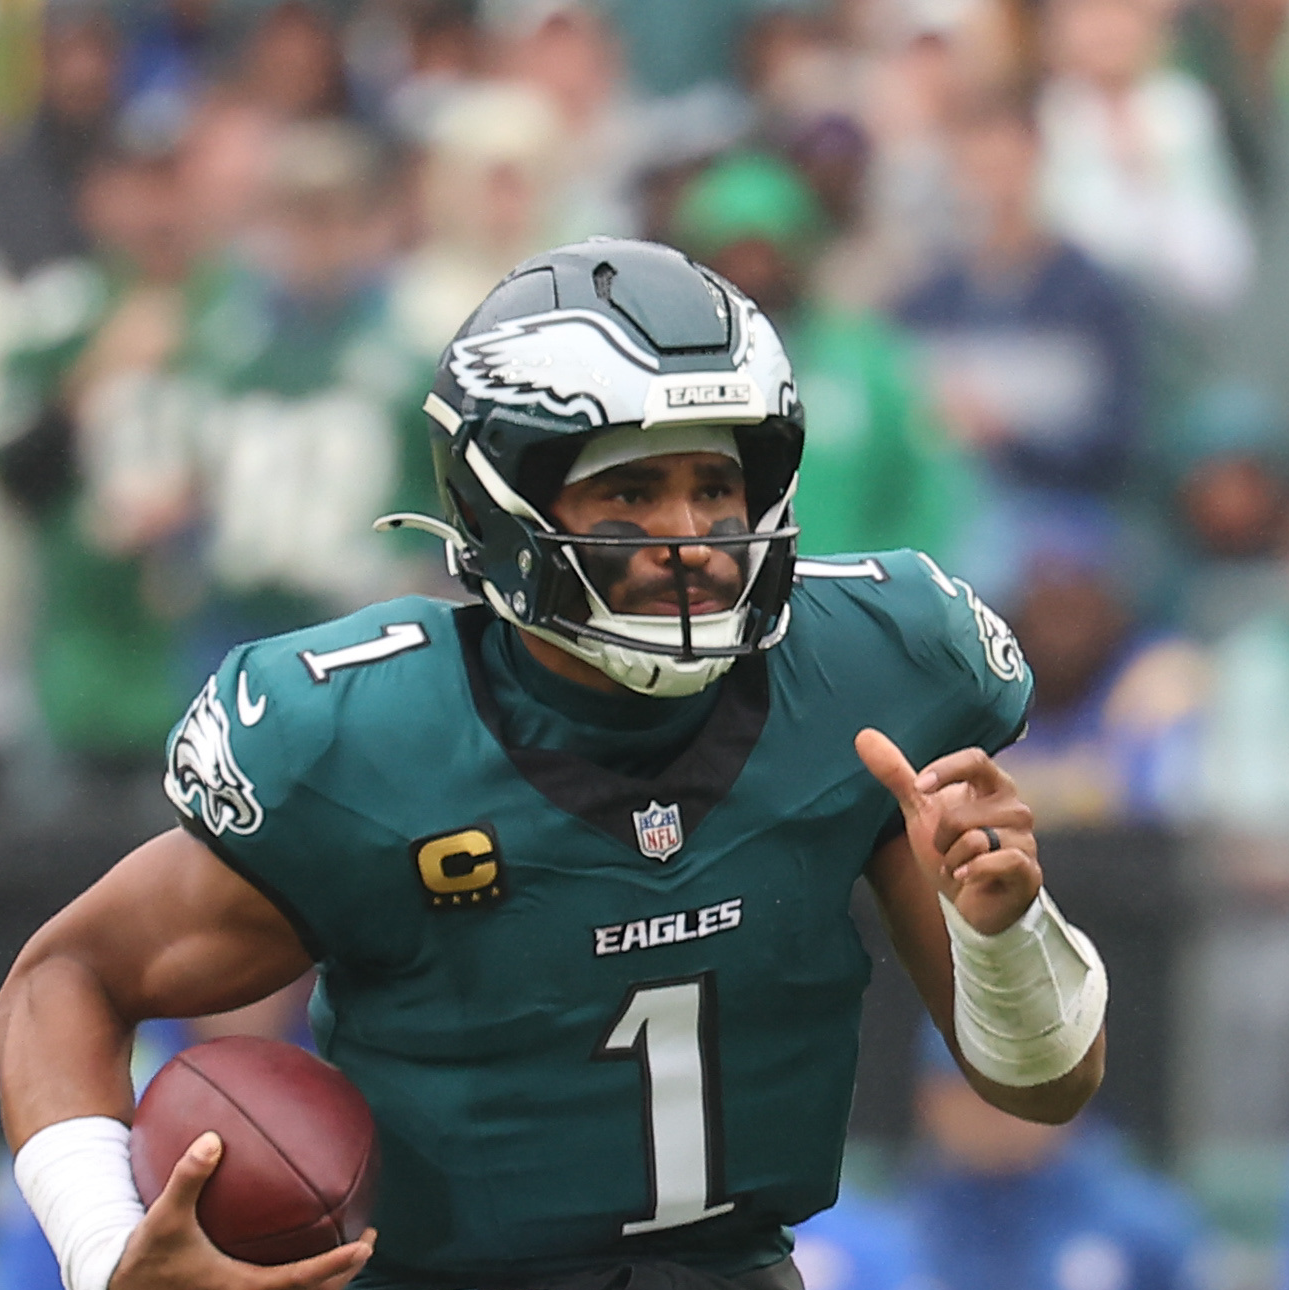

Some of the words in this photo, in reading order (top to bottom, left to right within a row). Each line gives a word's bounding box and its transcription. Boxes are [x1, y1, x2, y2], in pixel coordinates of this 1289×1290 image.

[667, 386, 750, 407] EAGLES
[299, 622, 430, 683] 1
[417, 828, 499, 895] C
[646, 828, 678, 850] NFL
[594, 898, 743, 956] EAGLES
[600, 977, 736, 1238] 1
